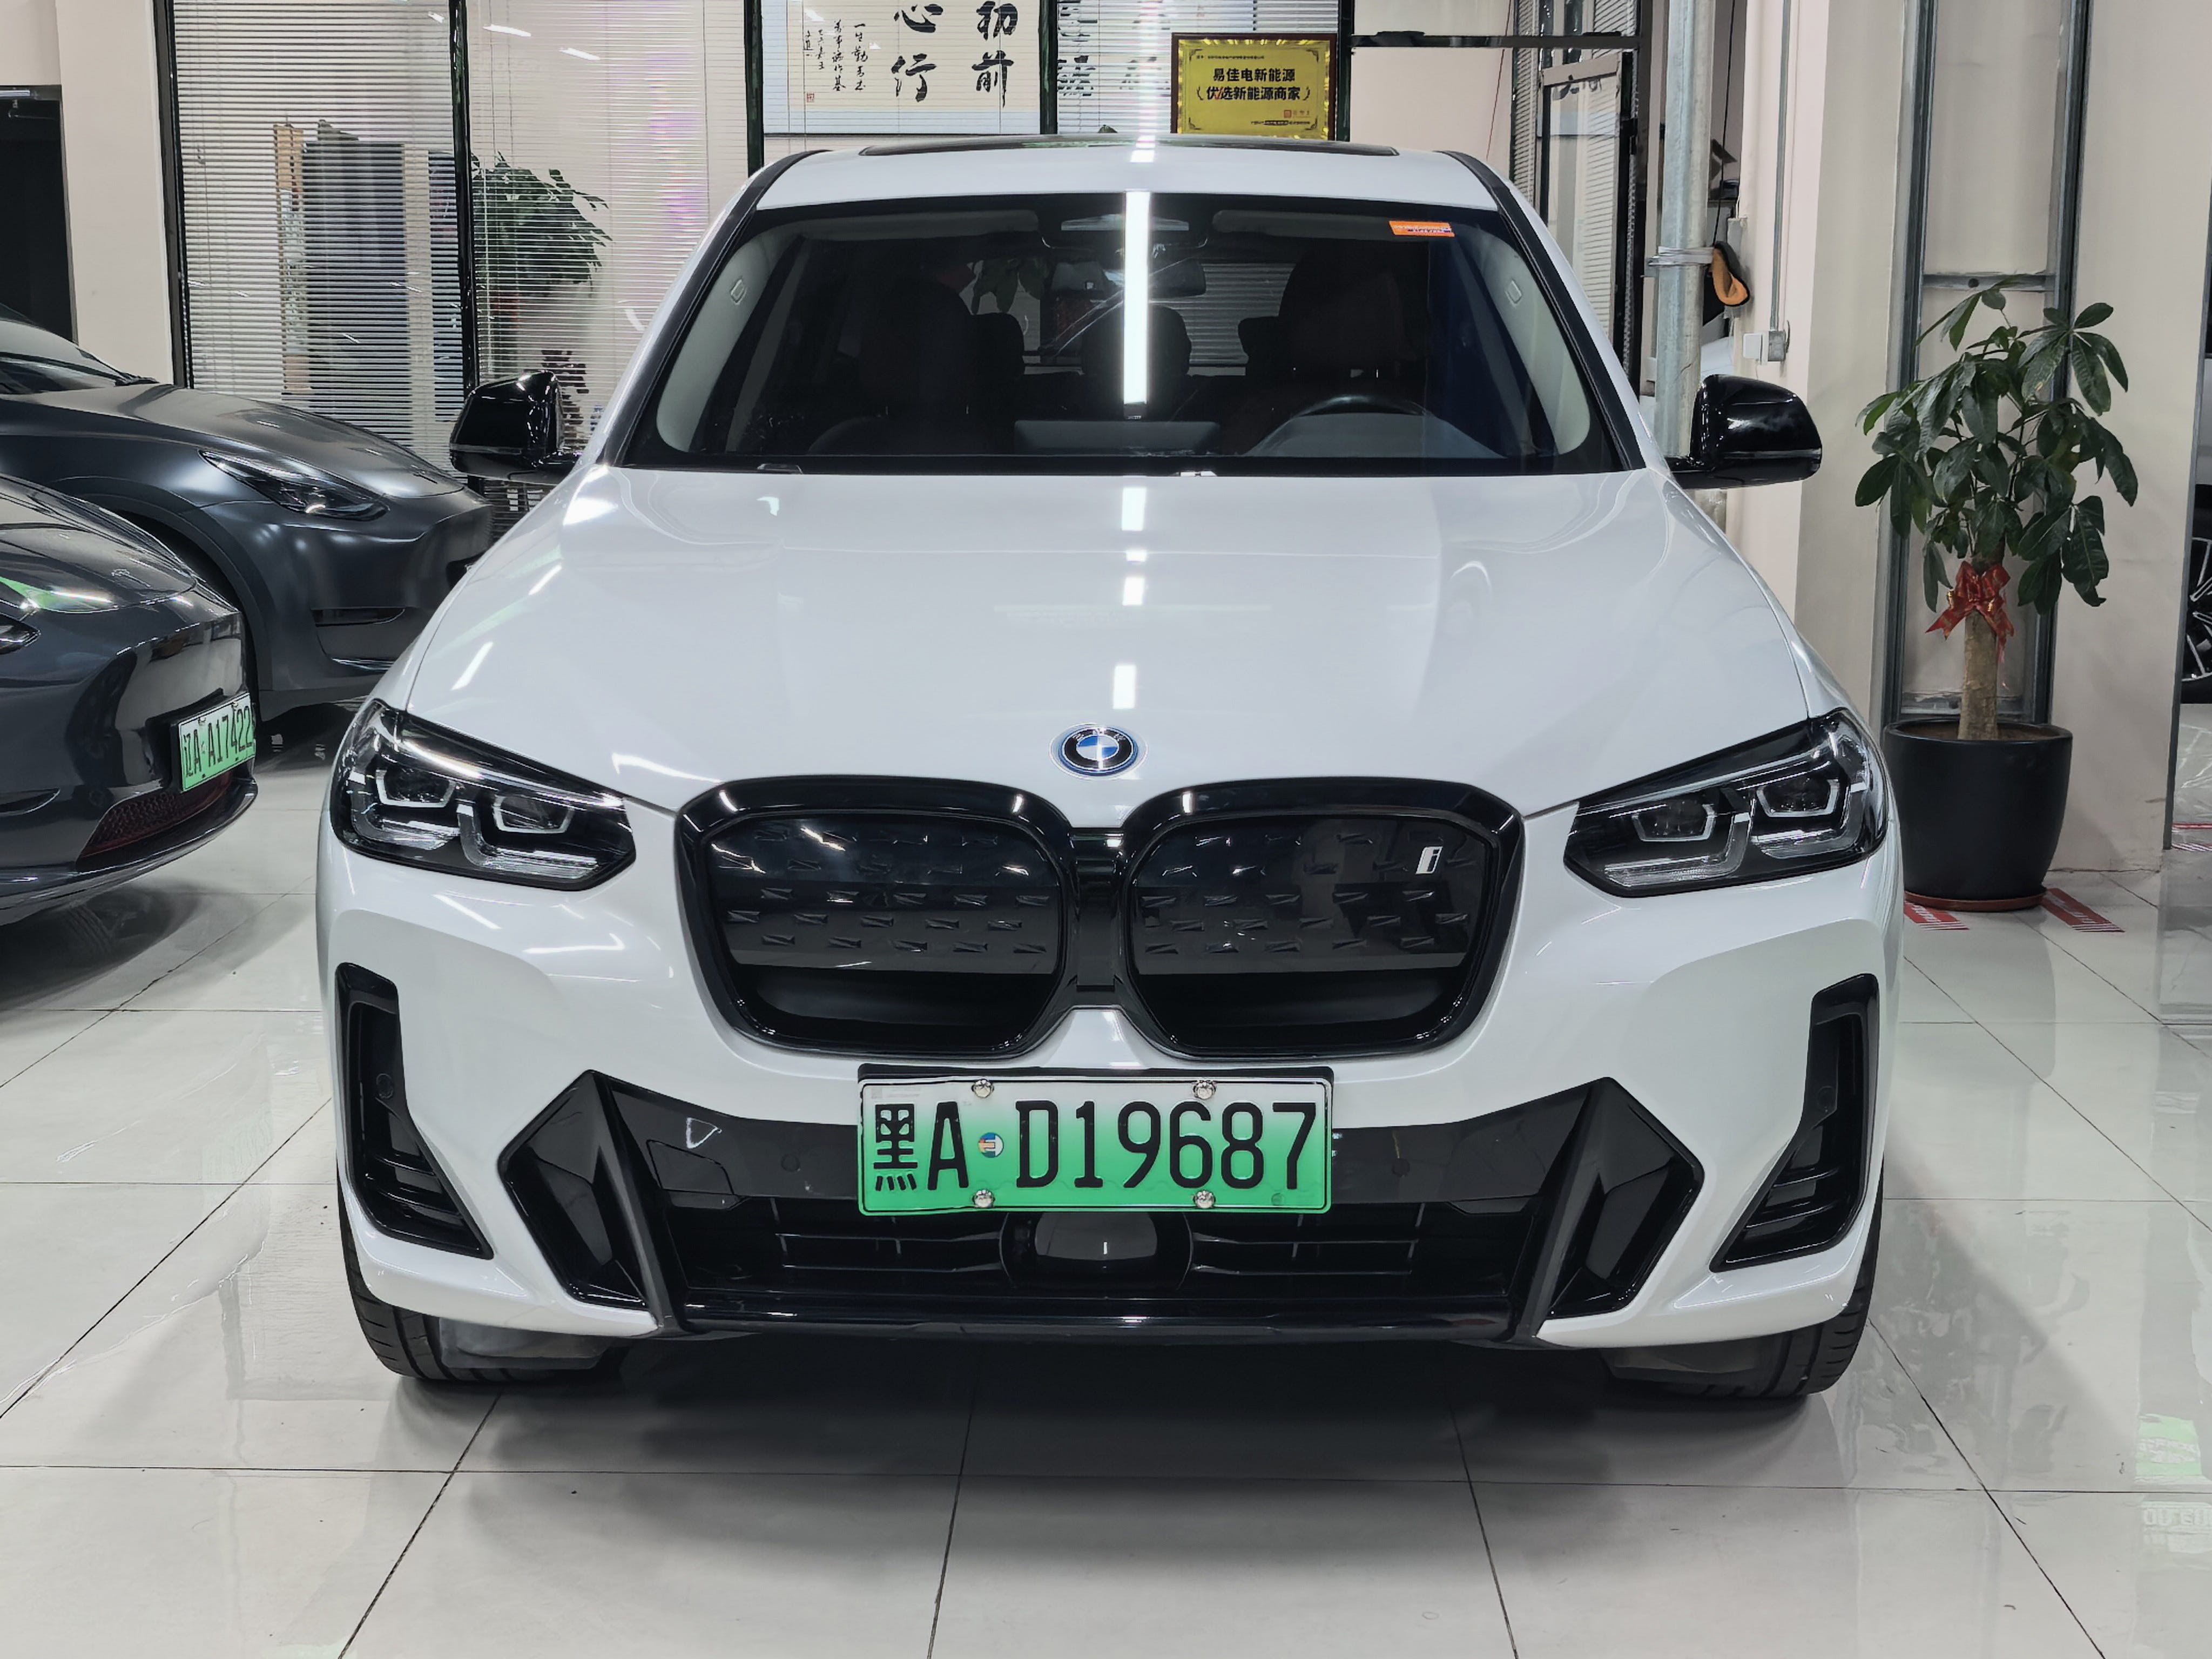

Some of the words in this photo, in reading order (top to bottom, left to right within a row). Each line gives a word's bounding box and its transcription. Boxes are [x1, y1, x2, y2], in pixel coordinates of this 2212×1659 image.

[1206, 86, 1301, 101] 优选新能源商家
[1213, 68, 1296, 82] 易佳电新能源
[207, 705, 253, 767] A17422
[1015, 1100, 1317, 1190] D19687
